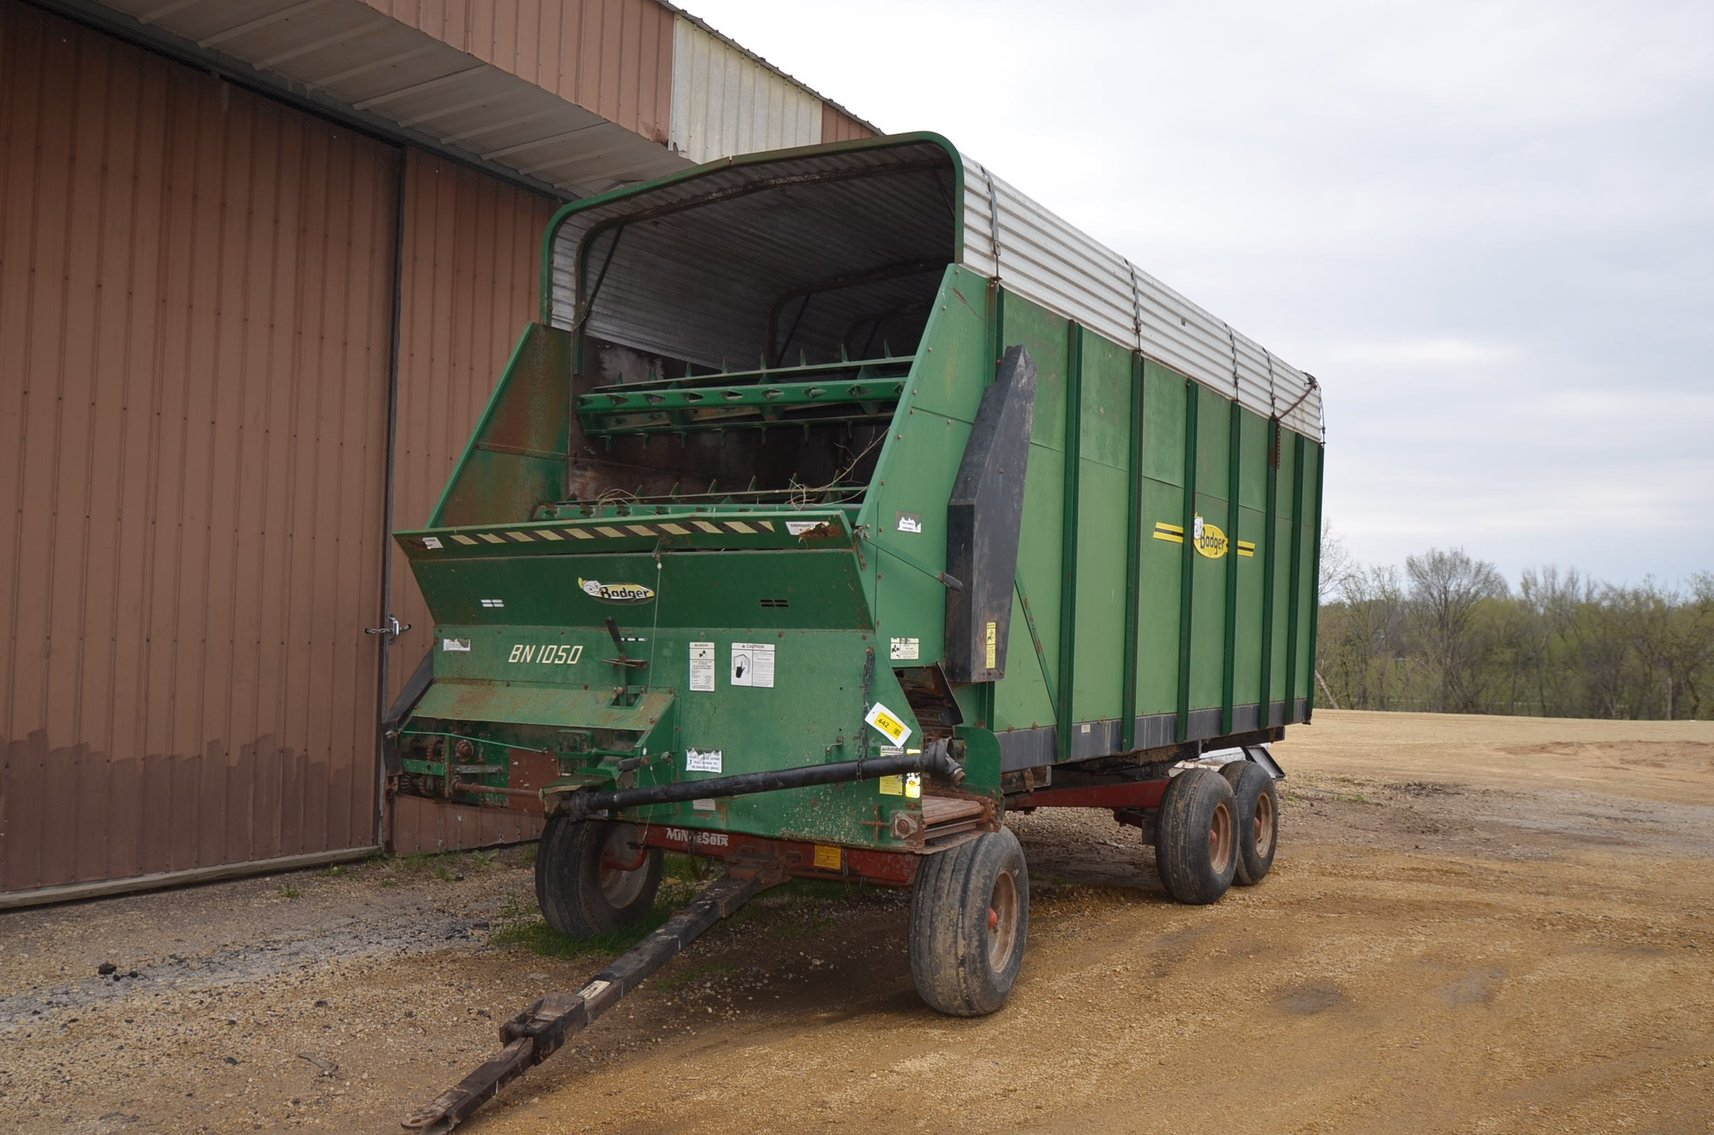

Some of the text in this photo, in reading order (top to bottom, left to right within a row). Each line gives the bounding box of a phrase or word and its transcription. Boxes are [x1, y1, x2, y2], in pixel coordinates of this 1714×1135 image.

[1199, 526, 1225, 555] Badger
[599, 586, 650, 600] Badger
[508, 644, 584, 664] BN 1050
[877, 718, 890, 729] 442
